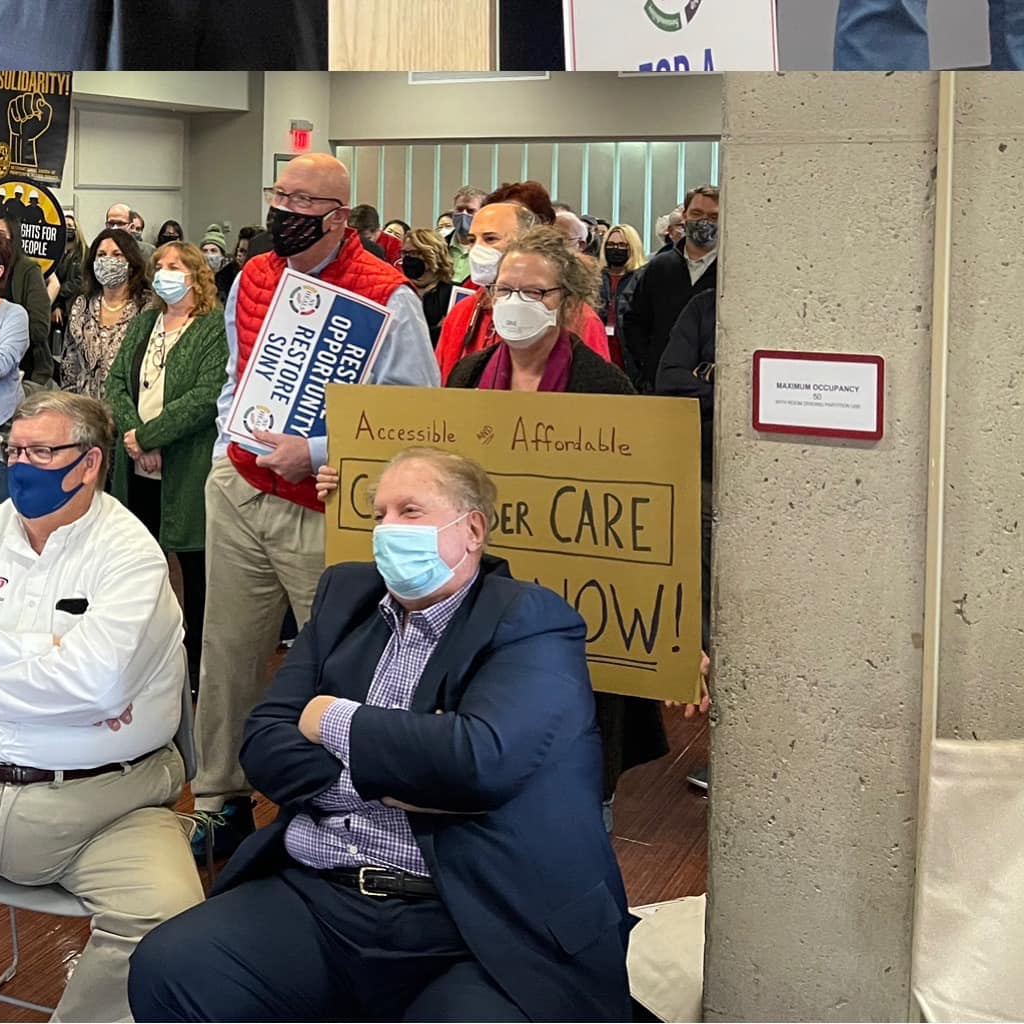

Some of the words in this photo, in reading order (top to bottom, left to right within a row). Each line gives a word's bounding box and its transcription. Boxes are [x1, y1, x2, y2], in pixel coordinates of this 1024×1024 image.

[41, 226, 57, 241] FOR
[254, 332, 287, 382] SUNY
[270, 325, 316, 406] RESTORE
[290, 314, 352, 438] OPPORTUNITY
[776, 381, 811, 391] MAXIMUM
[812, 383, 860, 393] OCCUPANCY
[355, 410, 456, 444] Accessible
[510, 416, 633, 457] Affordable
[550, 485, 652, 552] CARE
[534, 578, 682, 654] OW!
